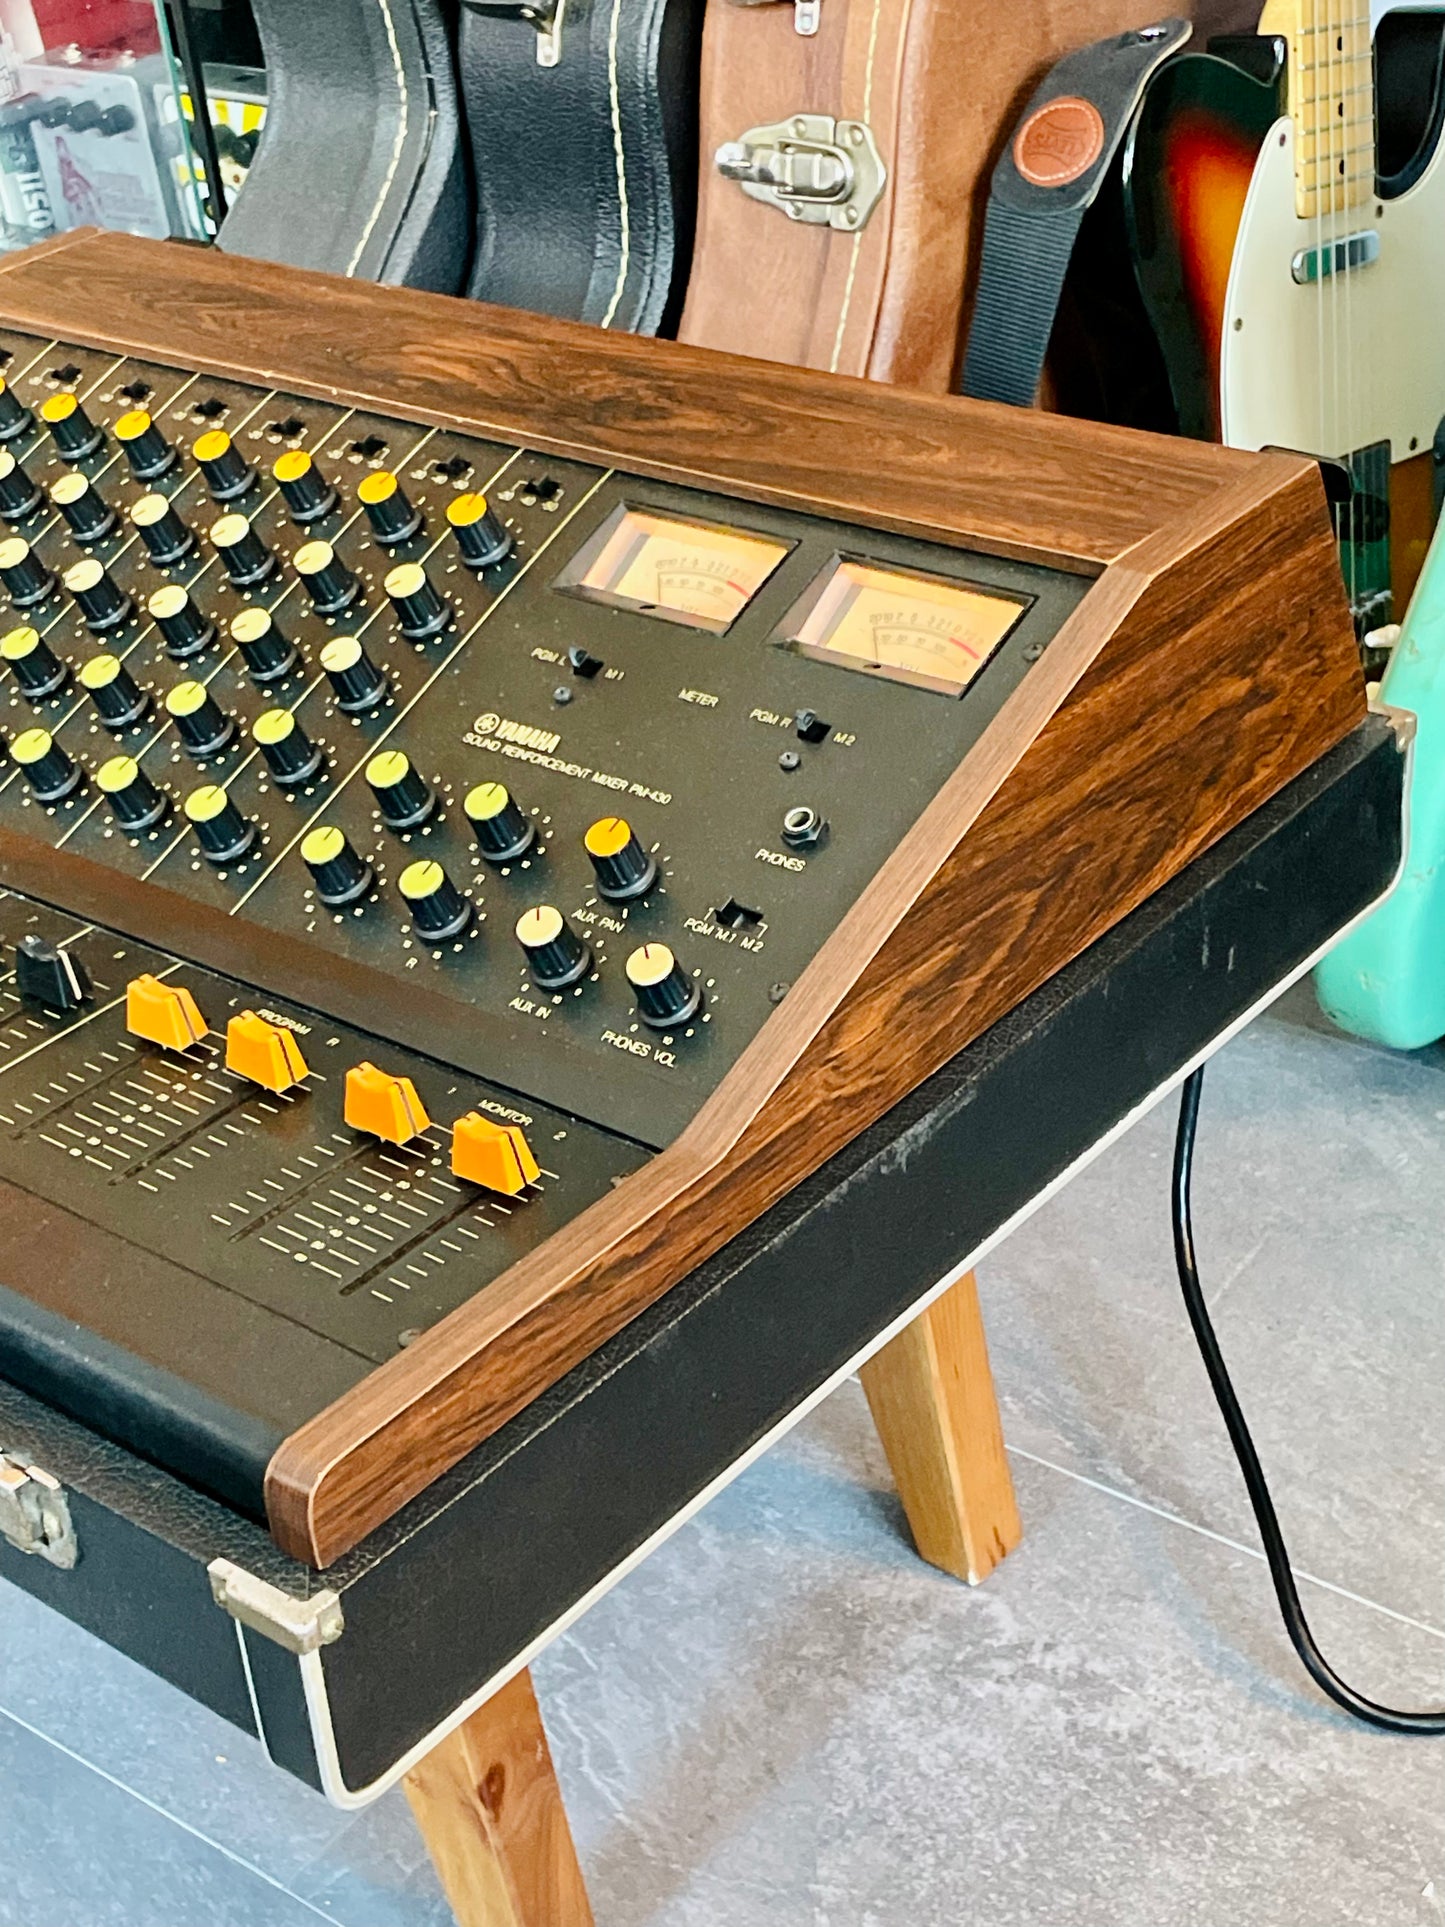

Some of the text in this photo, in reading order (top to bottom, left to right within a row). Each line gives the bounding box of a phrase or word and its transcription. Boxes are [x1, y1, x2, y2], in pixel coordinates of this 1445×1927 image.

[530, 647, 560, 664] PGM
[678, 687, 719, 708] METER
[749, 708, 793, 729] PGM R
[494, 718, 561, 754] YAMAHA
[832, 731, 856, 747] M2
[462, 732, 672, 805] SOUND REINFORCEMENT MIXER PM-430
[754, 848, 806, 872] PHONES
[570, 908, 626, 934] AUX PAN
[683, 917, 715, 936] PGM
[739, 936, 764, 953] M2
[508, 996, 552, 1020] AUX IN
[255, 1008, 313, 1035] PROGRAM
[600, 1030, 677, 1068] PHONES VOL
[477, 1099, 534, 1127] MONITOR
